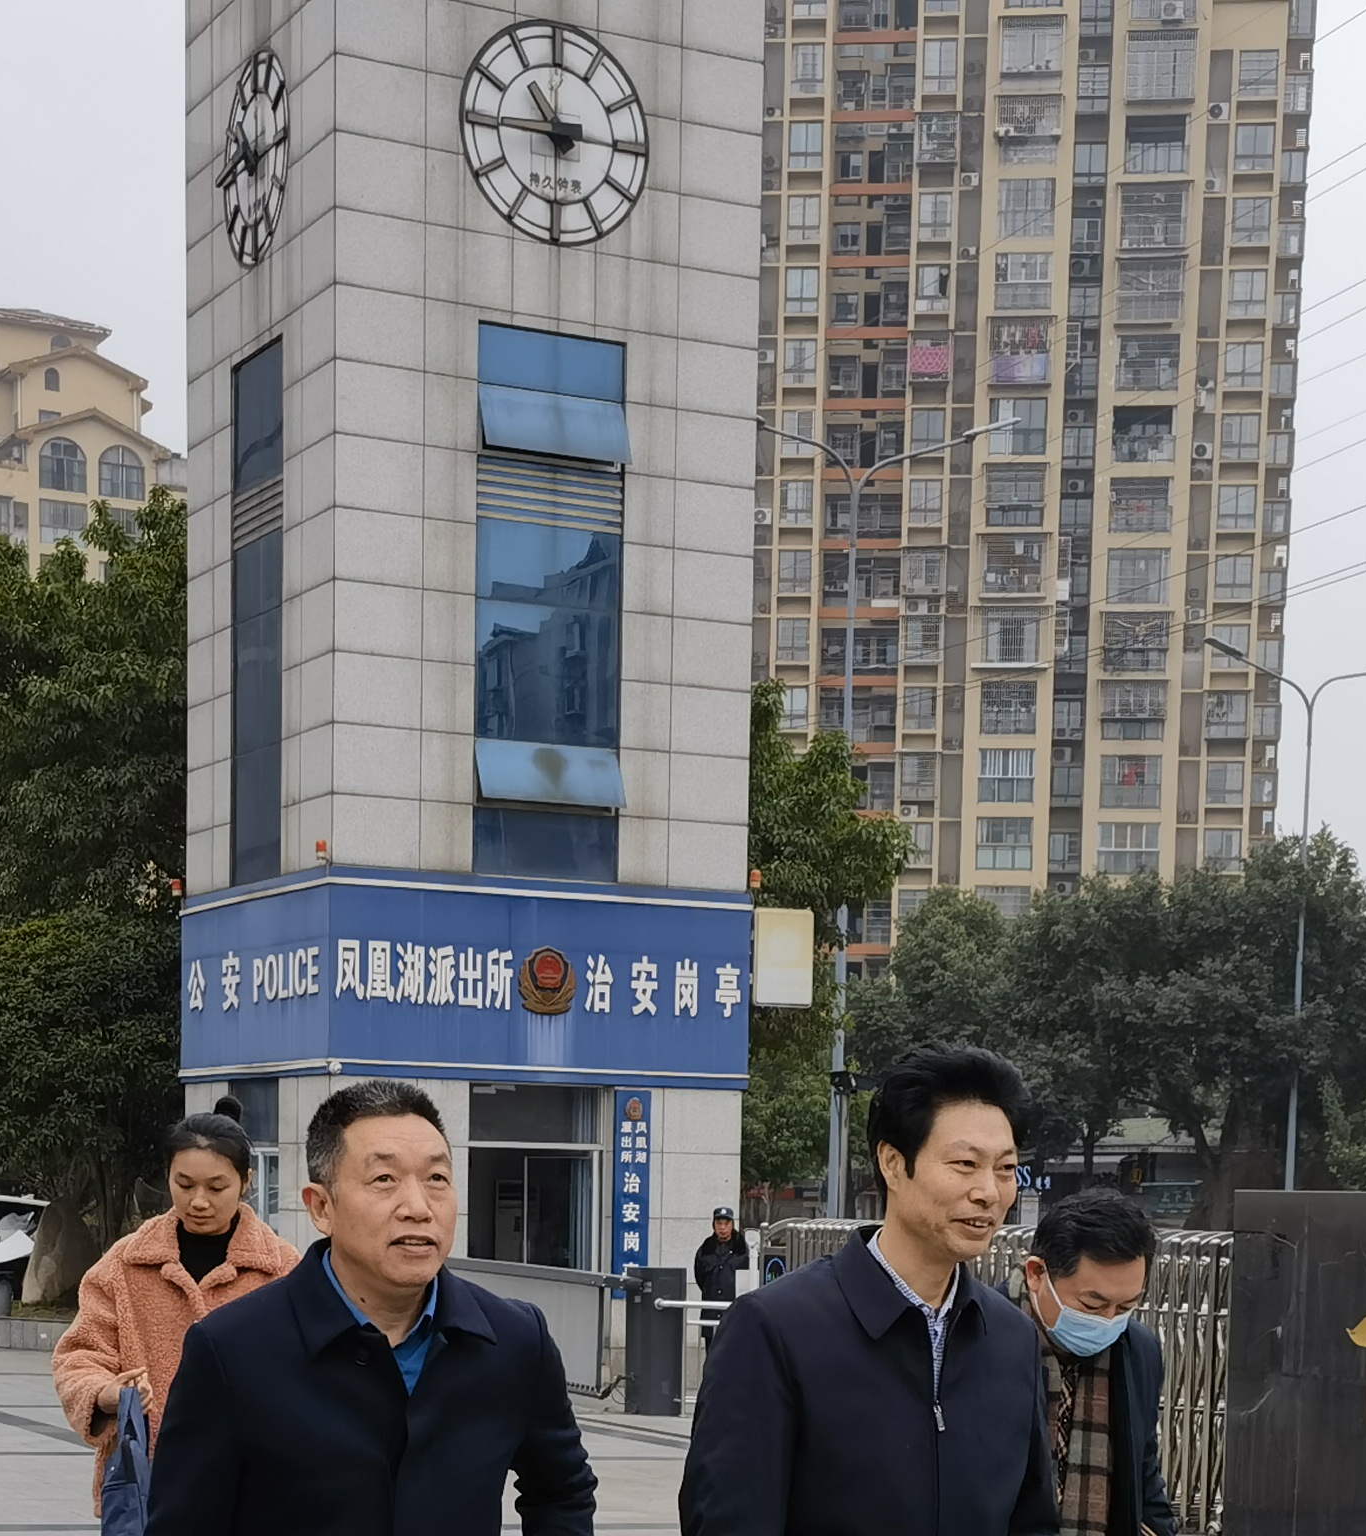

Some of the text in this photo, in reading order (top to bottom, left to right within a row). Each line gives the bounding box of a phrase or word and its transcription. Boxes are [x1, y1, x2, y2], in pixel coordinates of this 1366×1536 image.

[187, 946, 320, 1012] 公安 POLICE
[334, 938, 742, 1019] 凤凰湖派出所 治安岗亭
